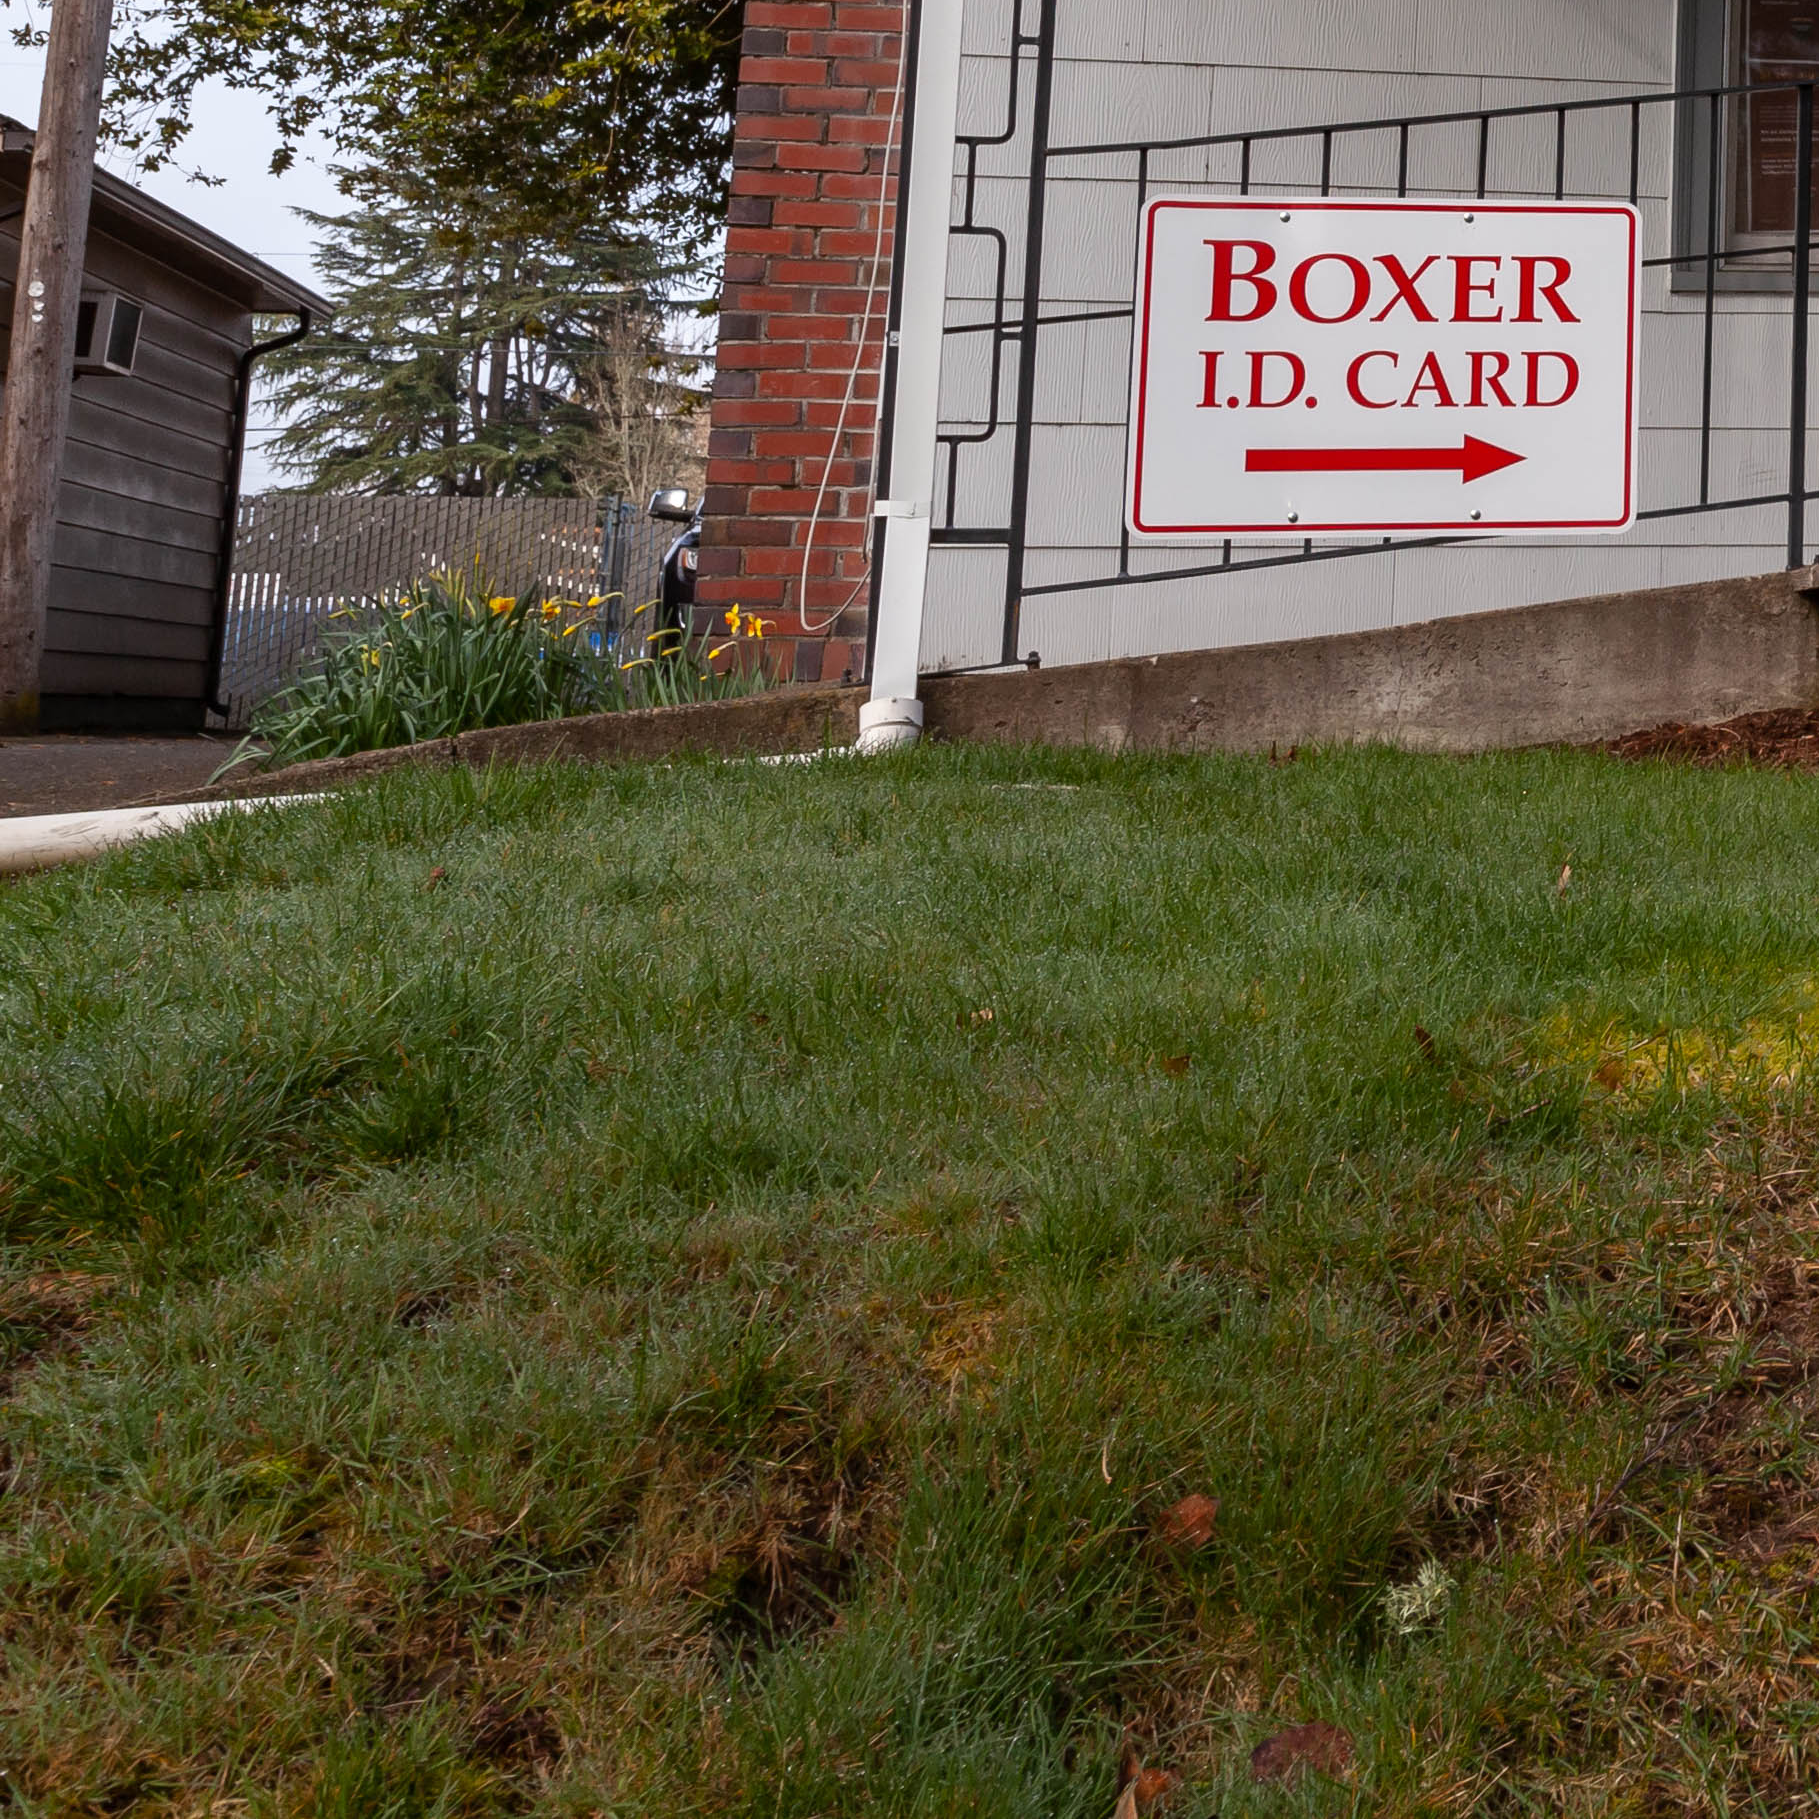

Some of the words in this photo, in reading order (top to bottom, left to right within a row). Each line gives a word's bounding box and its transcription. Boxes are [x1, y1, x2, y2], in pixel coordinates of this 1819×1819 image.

[1203, 239, 1581, 324] BOXER
[1196, 350, 1319, 409] I.D.
[1346, 350, 1580, 409] CARD
